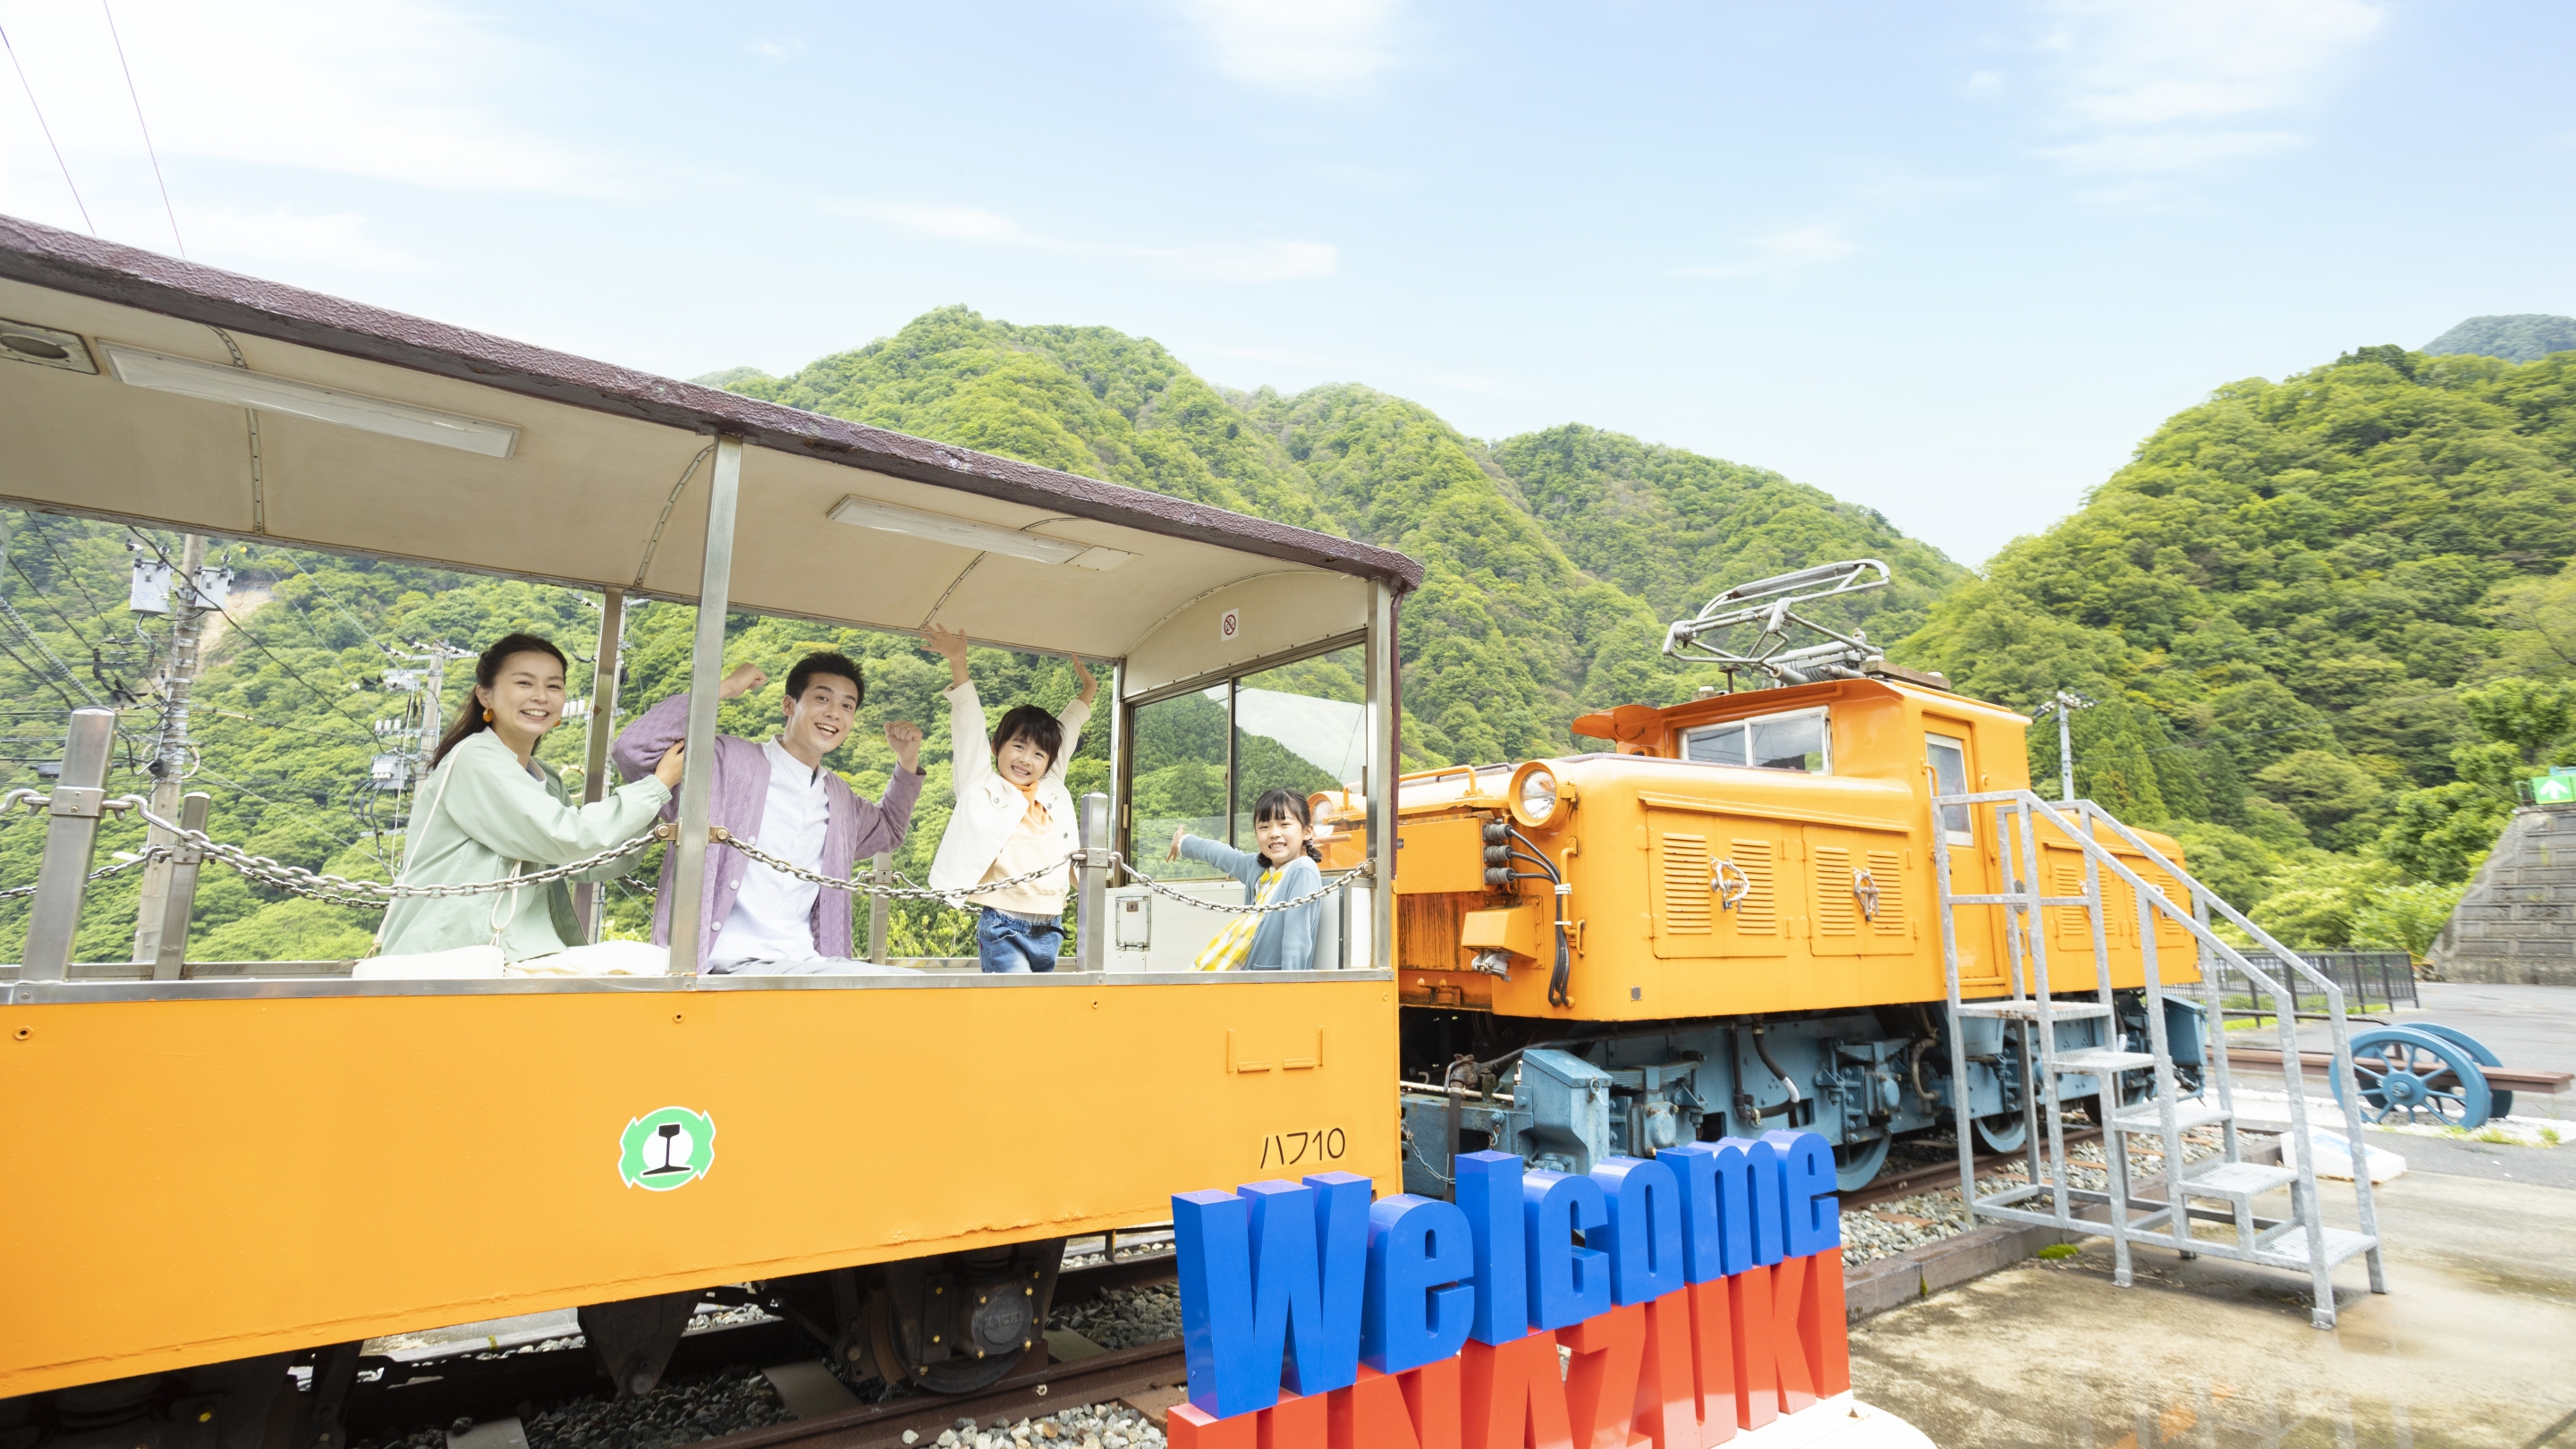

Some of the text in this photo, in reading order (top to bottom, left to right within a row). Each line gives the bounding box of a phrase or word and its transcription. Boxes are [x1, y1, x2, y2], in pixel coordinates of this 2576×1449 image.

[1259, 1127, 1346, 1169] ハフ10
[1167, 1247, 1851, 1449] AZUKI
[1171, 1129, 1839, 1420] Welcome
